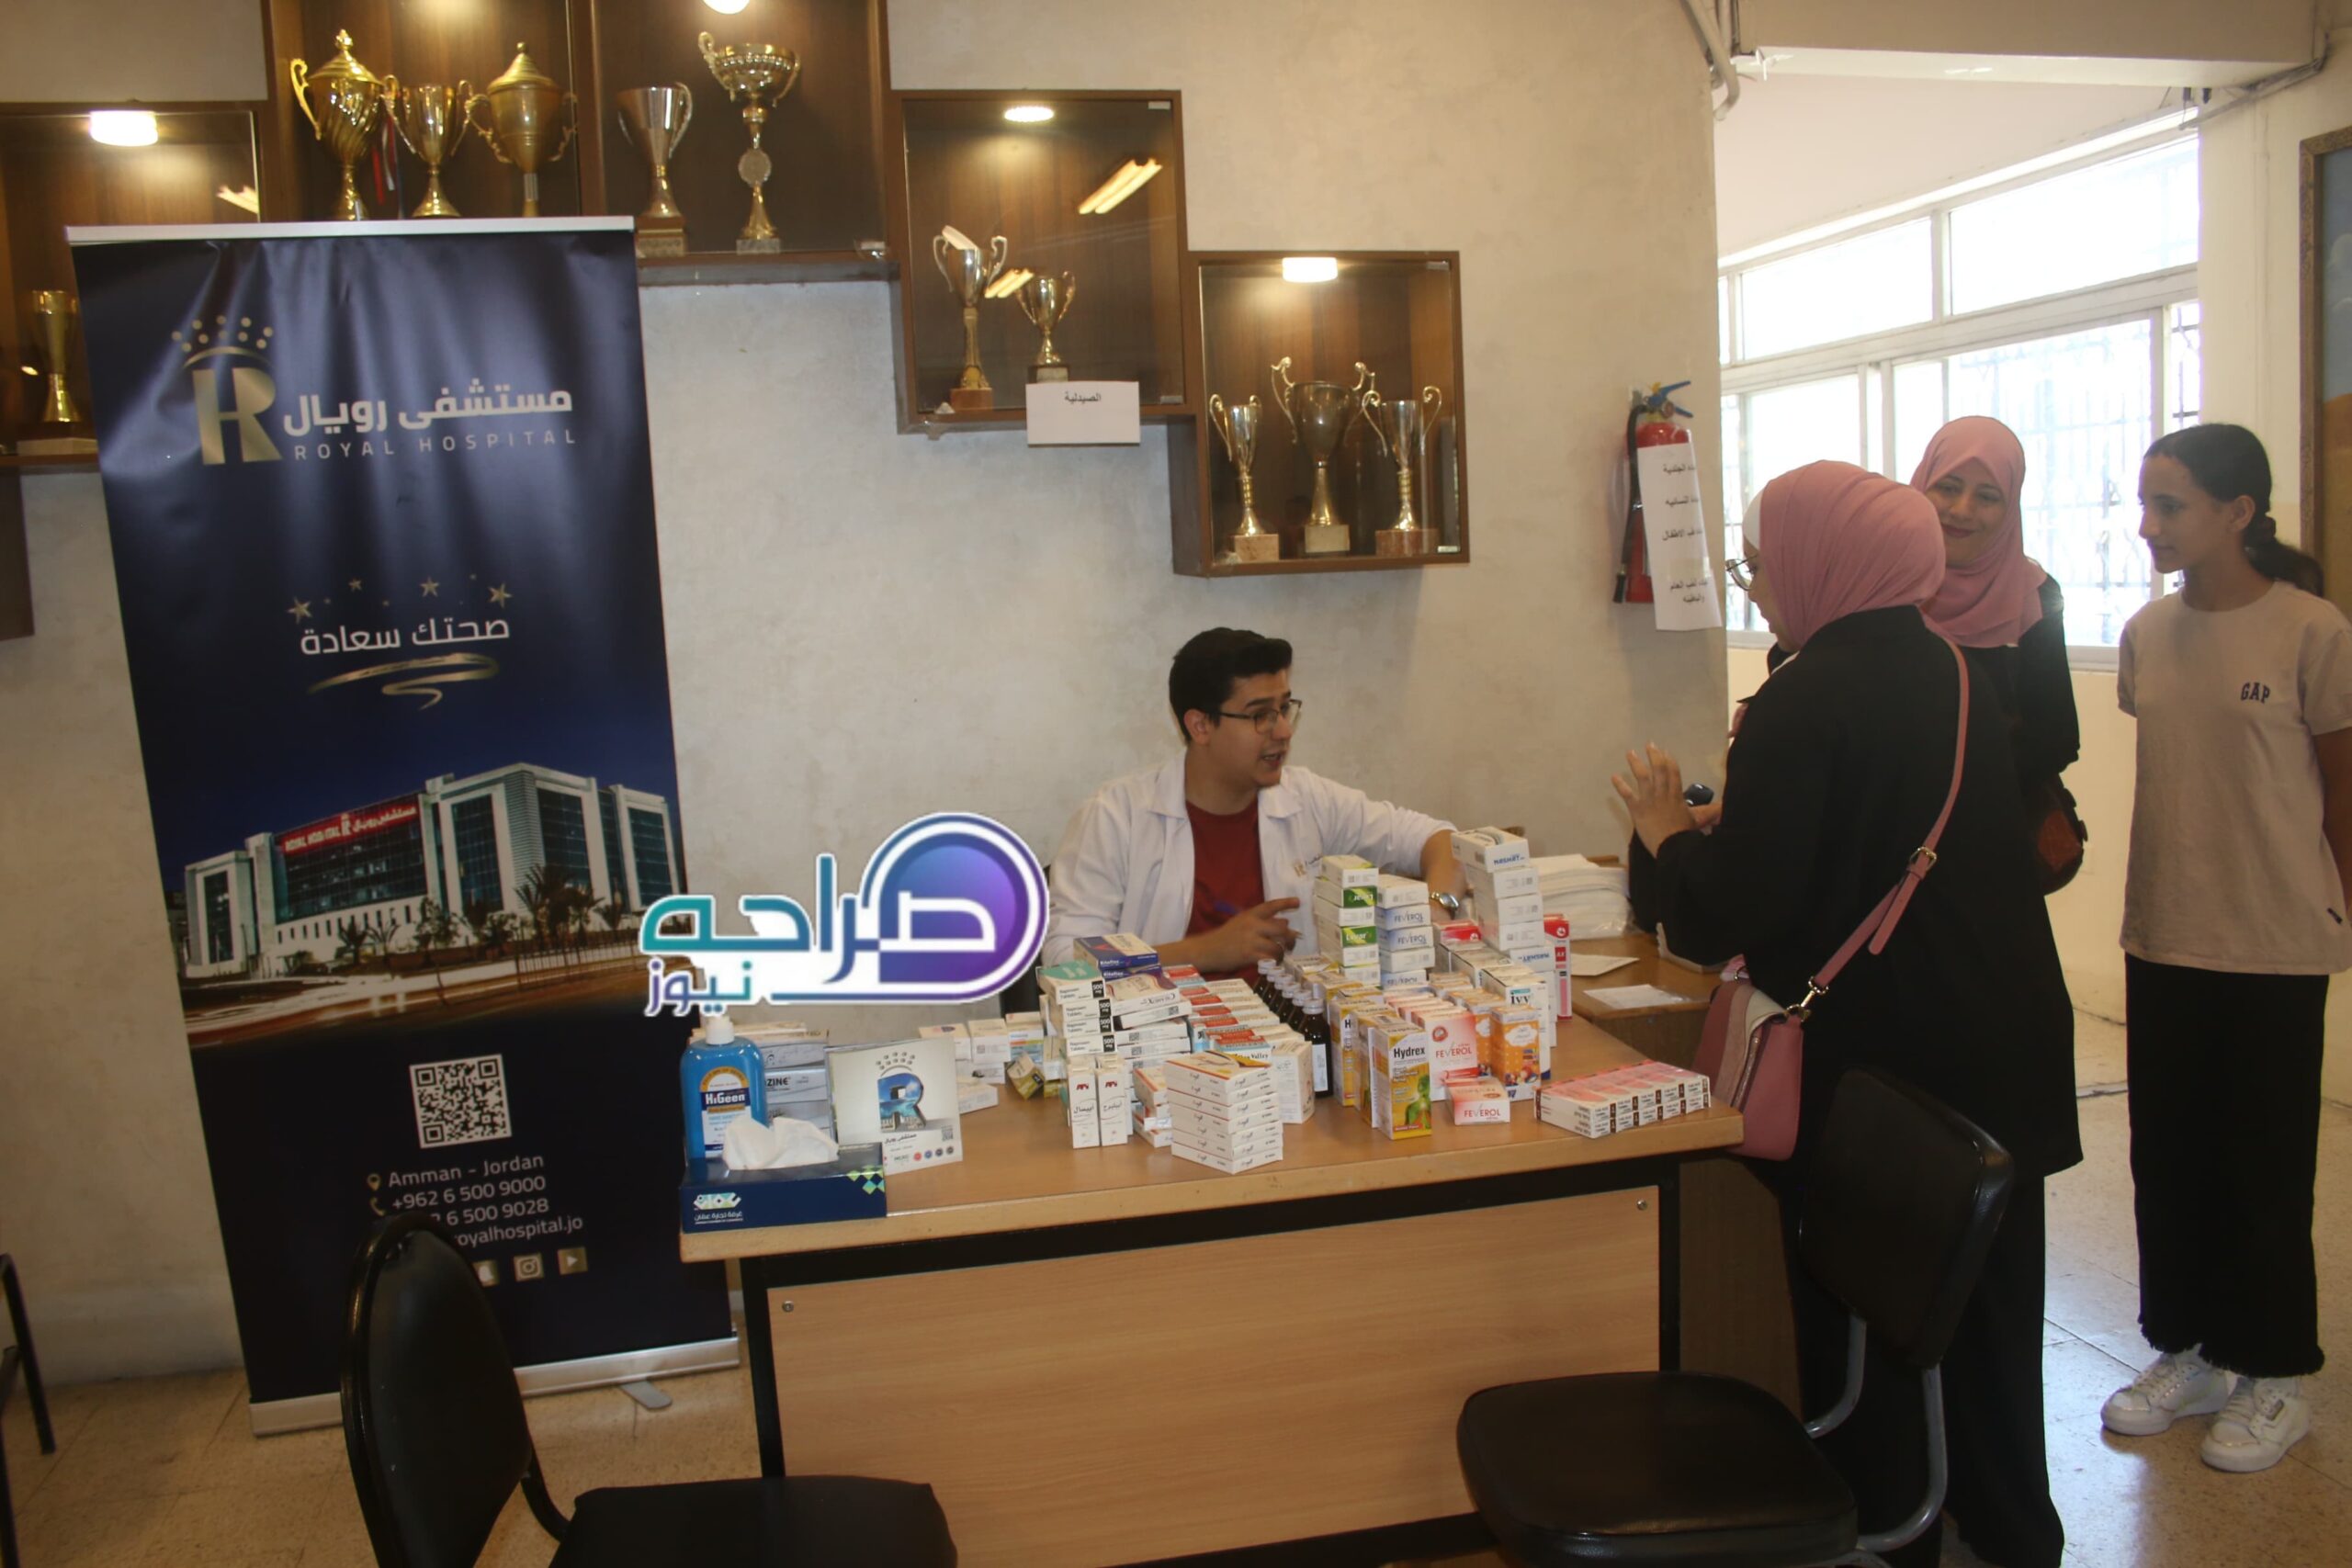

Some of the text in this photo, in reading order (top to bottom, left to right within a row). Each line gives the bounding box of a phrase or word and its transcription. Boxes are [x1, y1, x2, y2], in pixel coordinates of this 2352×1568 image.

[282, 378, 573, 436] مستشفى رويال
[1064, 390, 1102, 404] الصيدلية
[294, 430, 576, 461] ROYAL HOSPITAL
[300, 614, 511, 655] صحتك سعادة
[2240, 681, 2271, 705] GAP
[1394, 1046, 1425, 1059] Hydrex
[1435, 1043, 1472, 1058] FEVEROL
[705, 1091, 746, 1105] HiGeen
[1464, 1107, 1501, 1118] FEVEROL
[389, 1167, 461, 1189] Amman
[483, 1155, 544, 1177] Jordan
[392, 1176, 546, 1211] +962 6 500 9000
[447, 1211, 459, 1226] 6
[463, 1205, 498, 1224] 500
[502, 1198, 549, 1220] 9028
[455, 1216, 583, 1247] oyalhospital.jo
